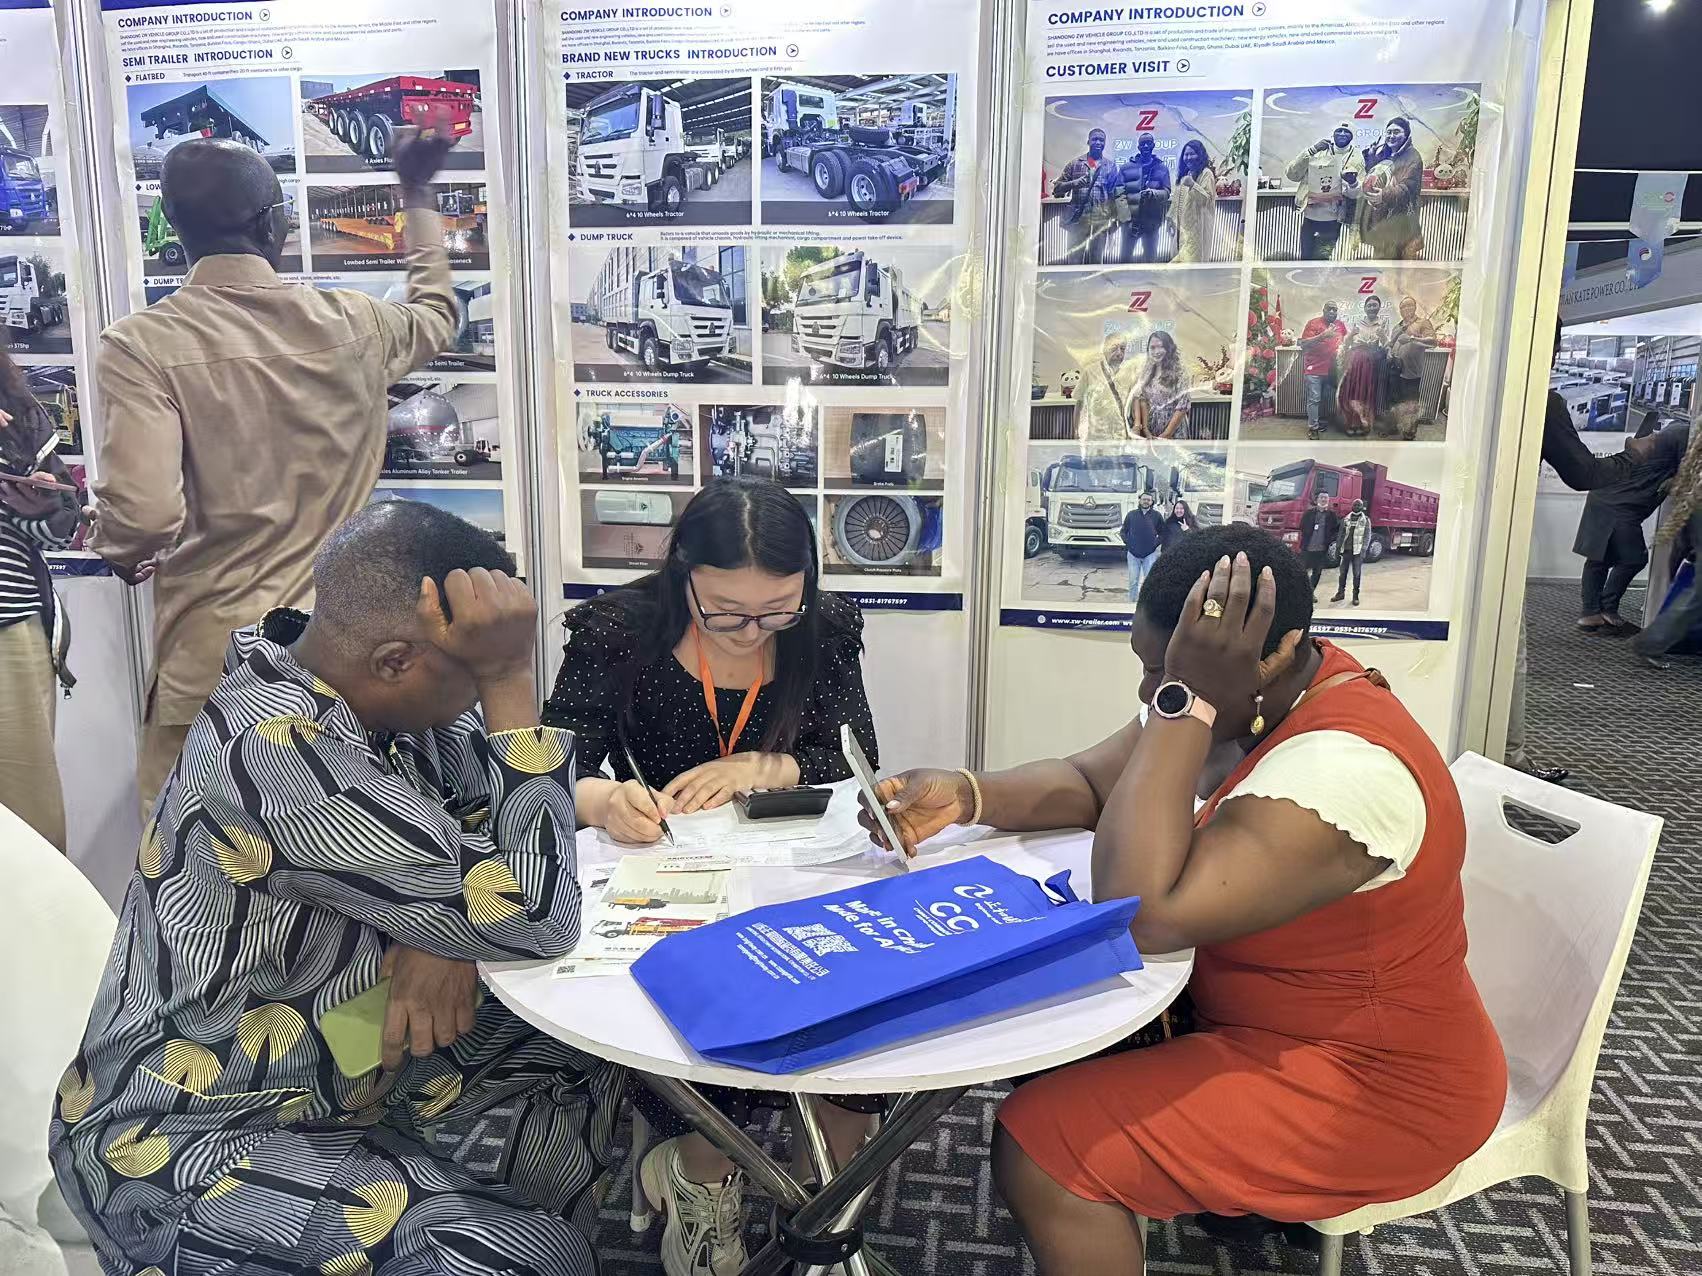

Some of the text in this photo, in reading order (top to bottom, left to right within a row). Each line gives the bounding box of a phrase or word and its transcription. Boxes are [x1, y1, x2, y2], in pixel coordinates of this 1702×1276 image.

[118, 15, 169, 28] COMPANY
[172, 11, 252, 25] INTRODUCTION
[561, 7, 712, 21] COMPANY INTRODUCTION
[1048, 5, 1244, 25] COMPANY INTRODUCTION
[123, 49, 273, 68] SEMI TRAILER INTRODUCTION
[562, 46, 777, 63] BRAND NEW TRUCKS INTRODUCTION
[1046, 60, 1170, 77] CUSTOMER VISIT
[135, 72, 165, 82] FLATBED
[576, 70, 614, 80] TRACTOR
[1113, 139, 1132, 149] ZW
[580, 233, 634, 241] DUMP TRUCK
[154, 278, 175, 286] DUMP
[586, 389, 668, 398] TRUCK ACCESSORIES
[854, 921, 881, 936] for
[877, 917, 897, 928] in
